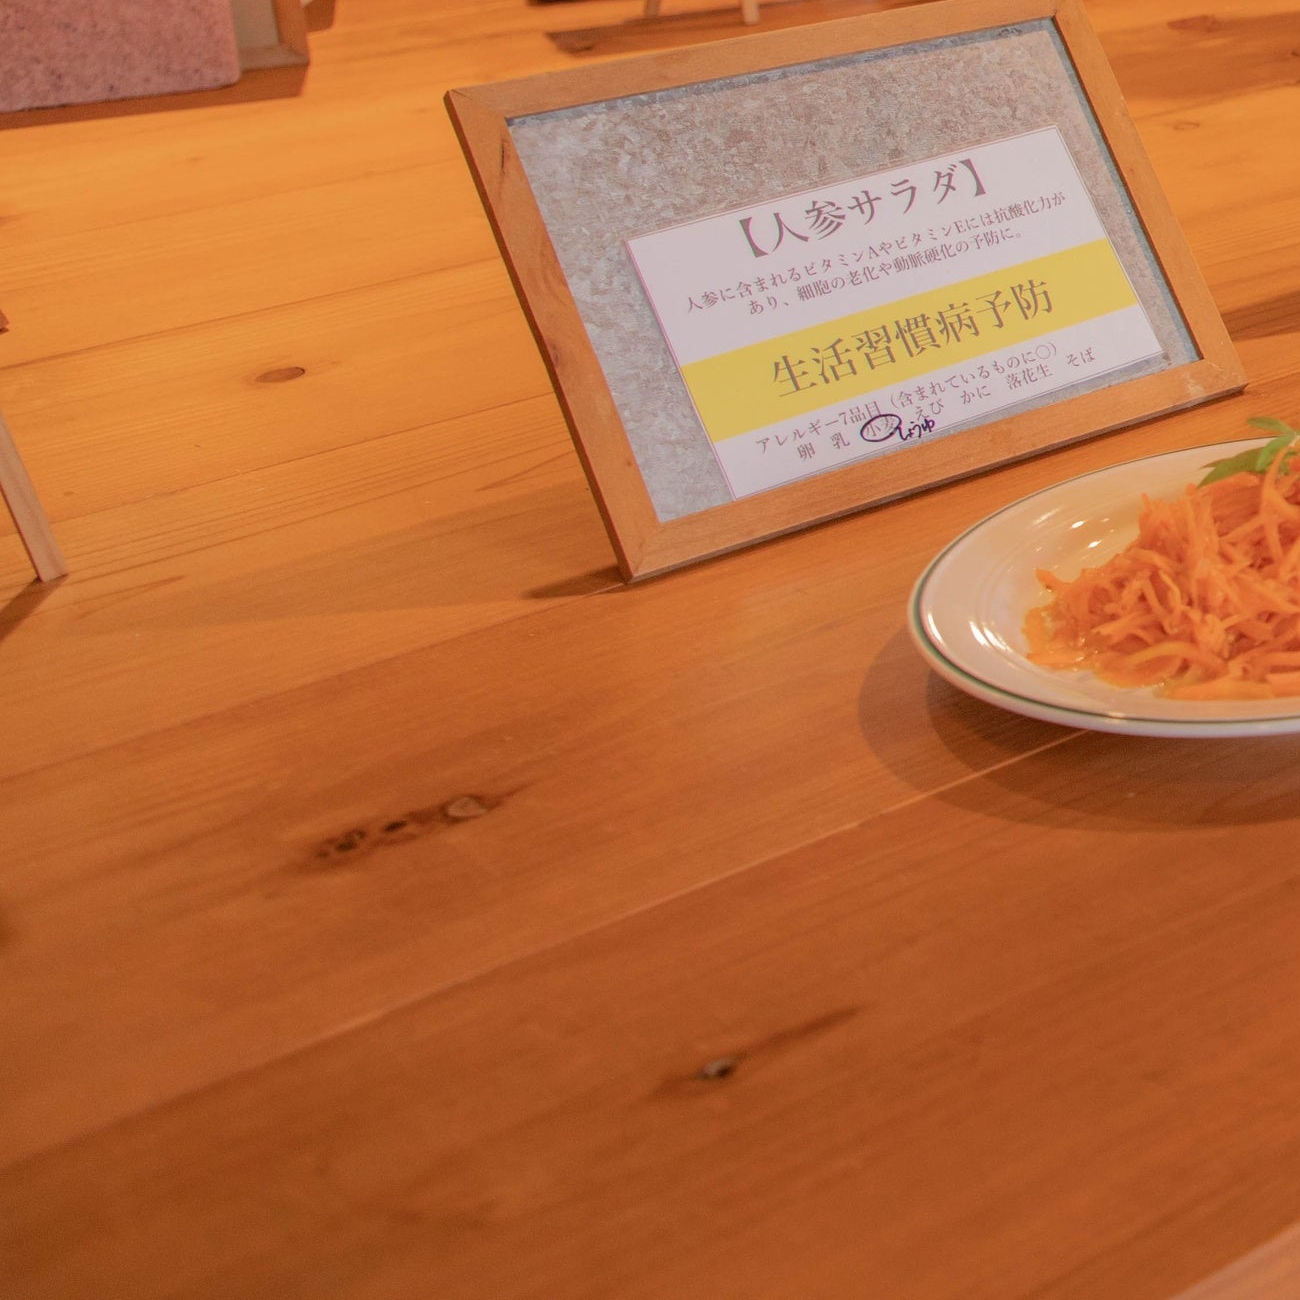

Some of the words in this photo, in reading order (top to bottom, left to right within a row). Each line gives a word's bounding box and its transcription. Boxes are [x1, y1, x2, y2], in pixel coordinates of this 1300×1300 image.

[687, 190, 1067, 315] 人参に含まれるビタミンAやビタミンEには抗酸化力が
[739, 158, 987, 258] 【人参サラダ】
[748, 226, 1023, 316] あり、細胞の老化や動脈硬化の予防に。
[773, 279, 1054, 398] 生活習慣病予防
[796, 442, 817, 462] 卵
[831, 431, 851, 451] 乳
[914, 398, 945, 421] えび
[961, 384, 992, 405] かに
[1006, 363, 1054, 391] 落花生
[1066, 346, 1097, 368] そば
